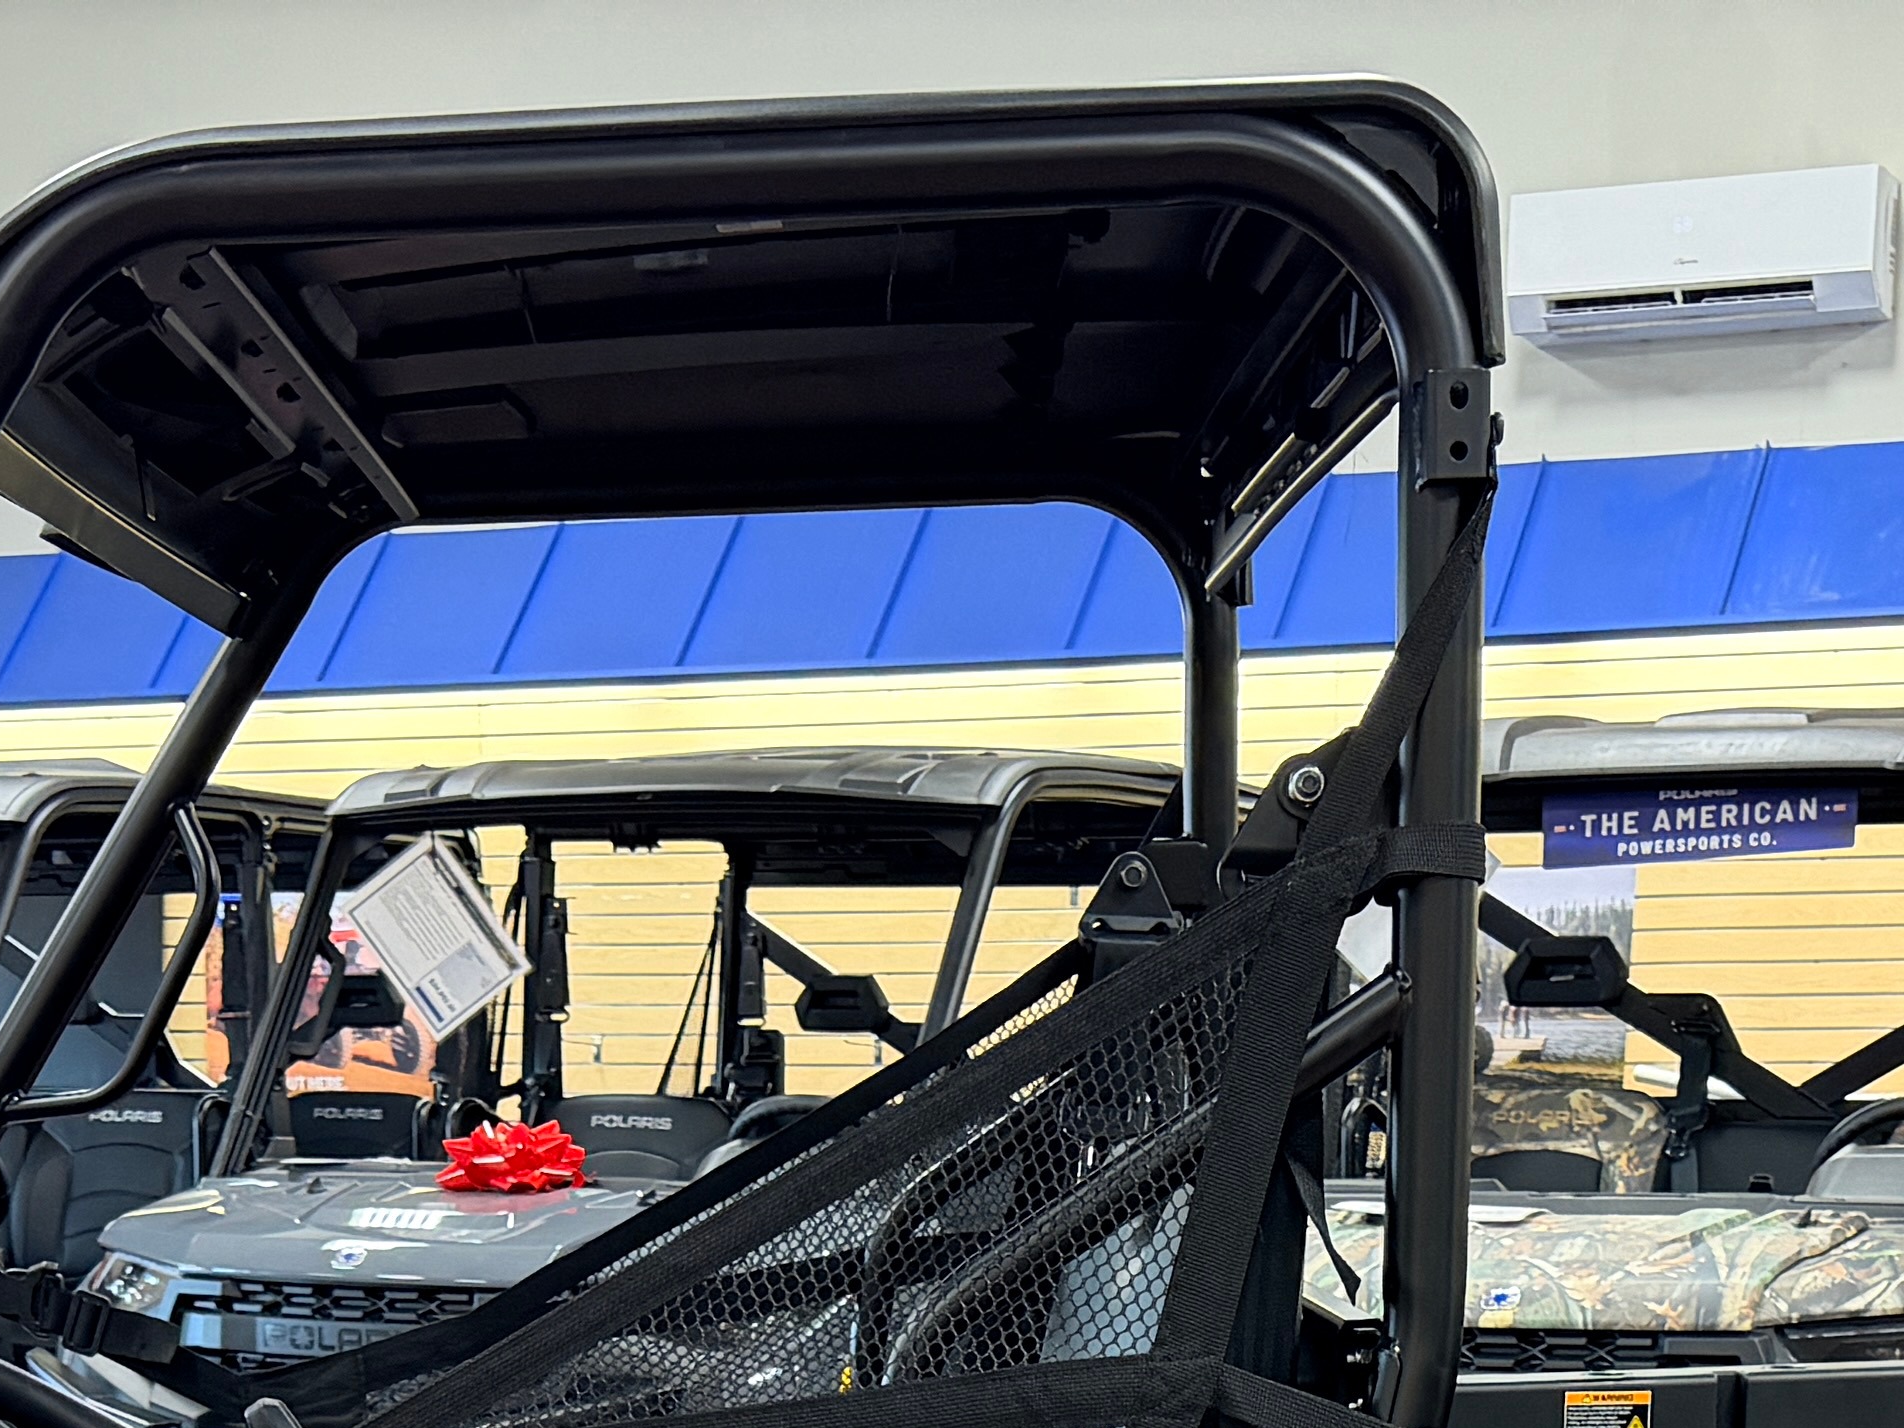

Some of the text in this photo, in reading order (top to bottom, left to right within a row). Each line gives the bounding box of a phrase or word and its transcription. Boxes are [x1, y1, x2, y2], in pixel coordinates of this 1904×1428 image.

[1580, 798, 1818, 838] THE AMERICAN
[1617, 832, 1777, 857] POWERSPORTS CO.
[89, 1110, 162, 1123] POLARIS
[313, 1107, 384, 1120] POLARIS
[590, 1114, 672, 1130] POLARIS
